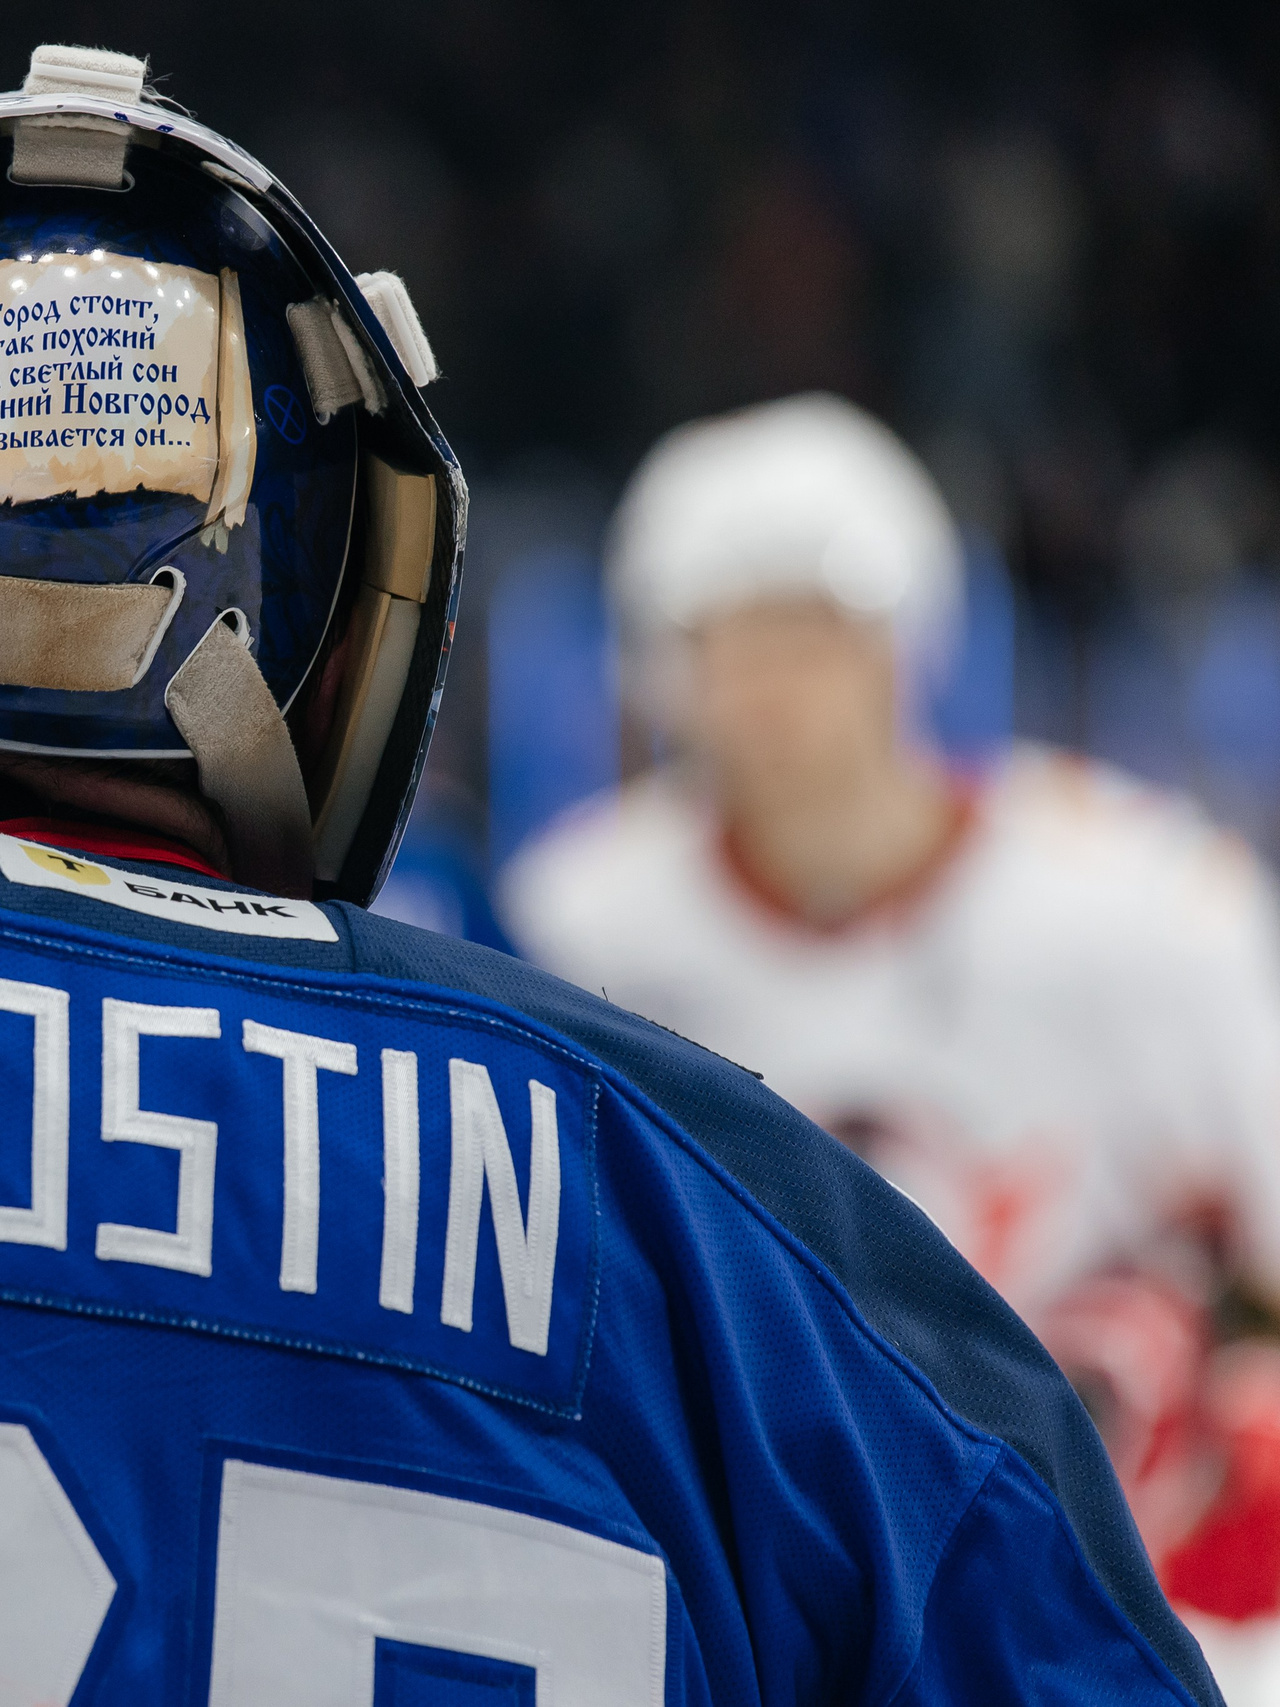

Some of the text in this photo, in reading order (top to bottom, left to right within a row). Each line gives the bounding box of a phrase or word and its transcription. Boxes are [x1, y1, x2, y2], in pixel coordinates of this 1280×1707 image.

[69, 294, 160, 325] стоит,
[41, 325, 156, 356] похожий
[8, 354, 123, 386] светлый
[131, 362, 178, 383] сон
[61, 382, 211, 425] Новгород
[133, 426, 191, 447] он...
[122, 880, 299, 919] БАНК
